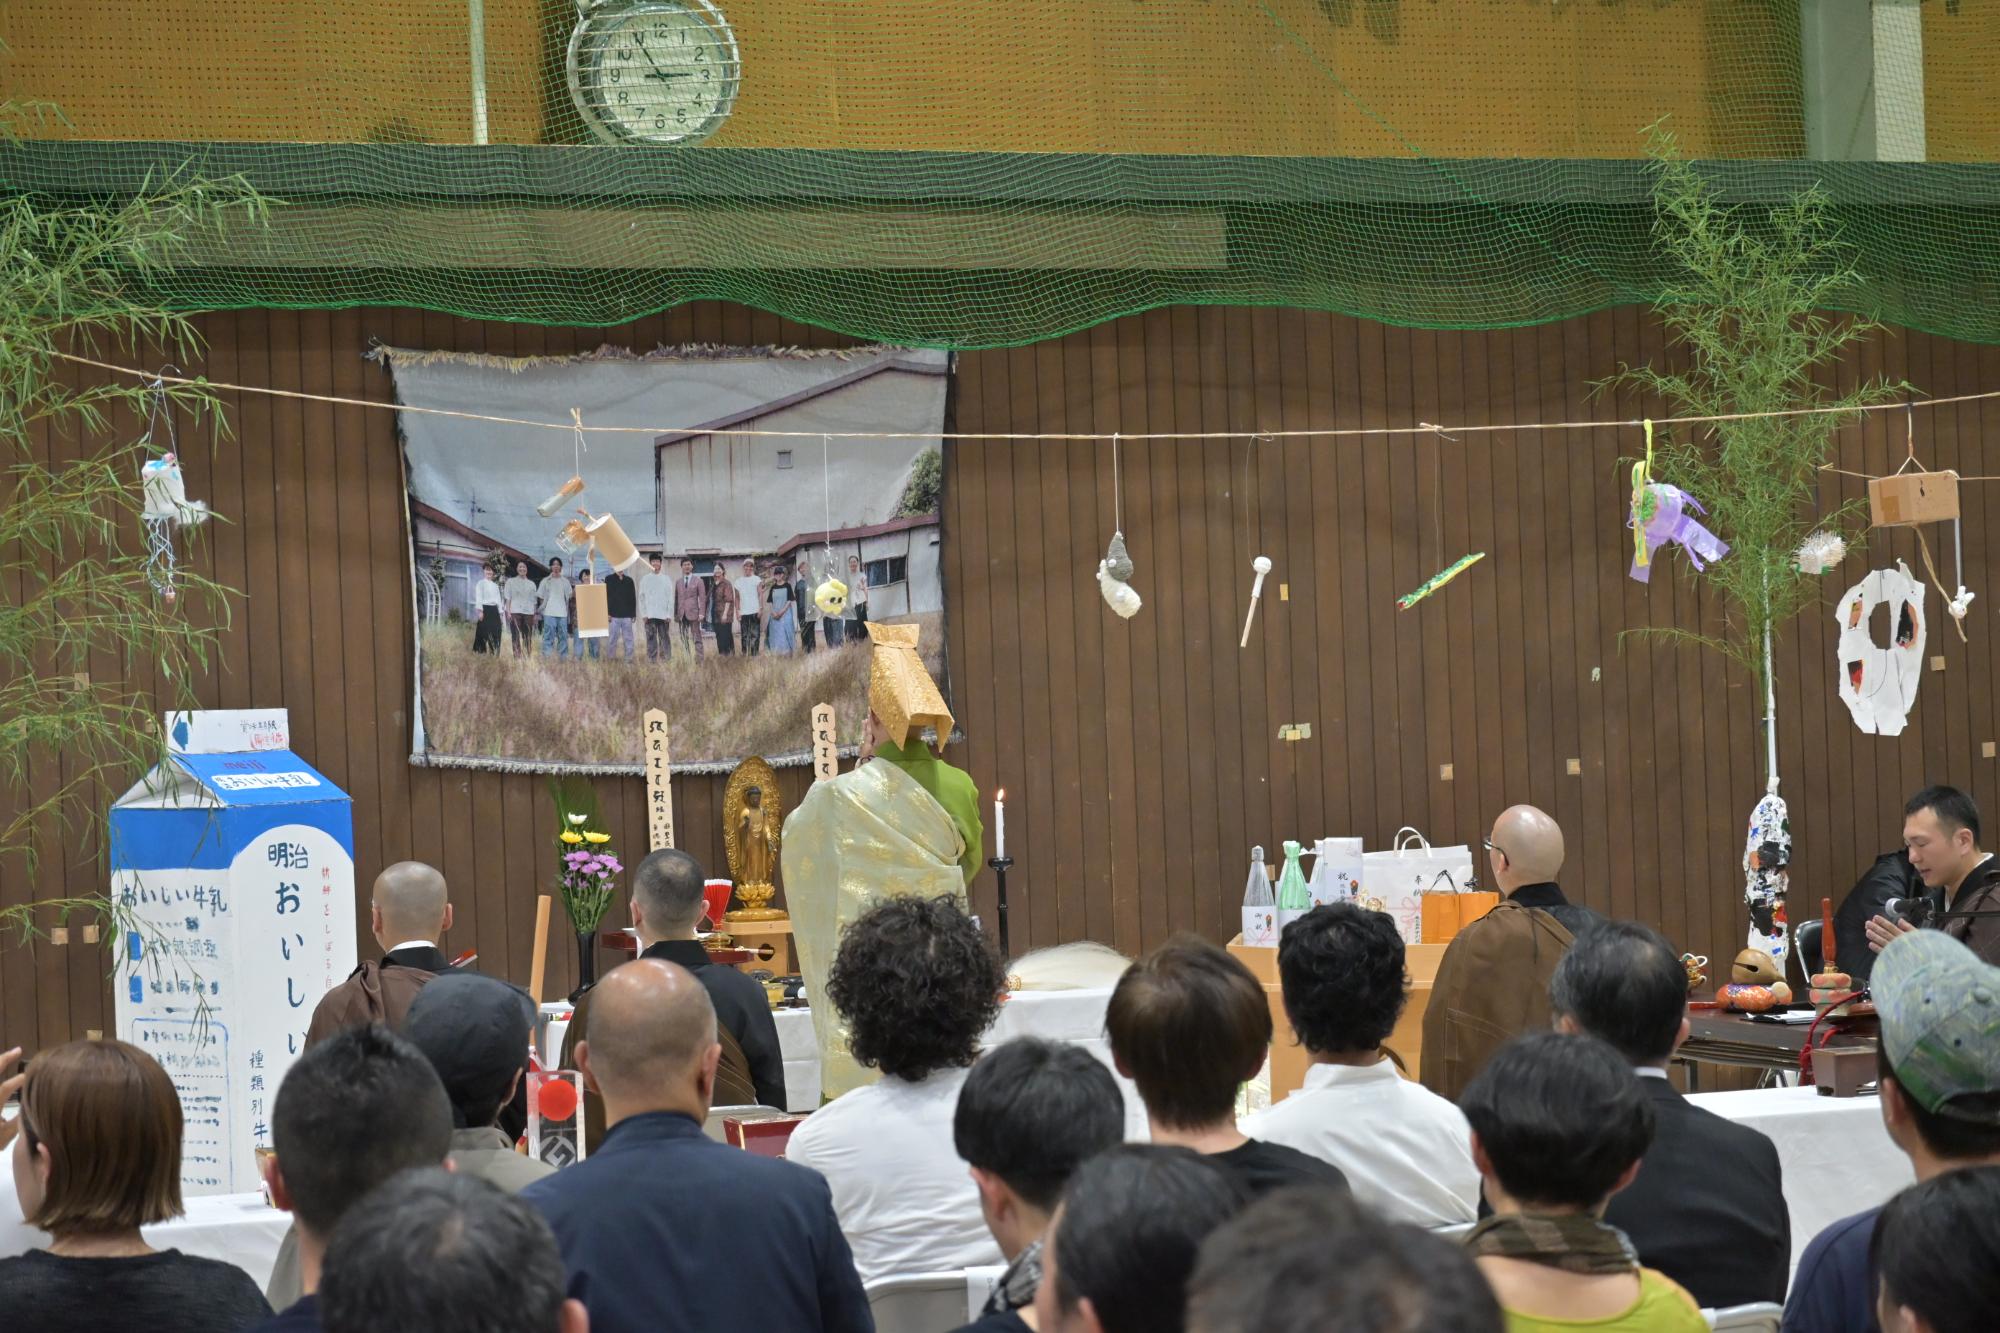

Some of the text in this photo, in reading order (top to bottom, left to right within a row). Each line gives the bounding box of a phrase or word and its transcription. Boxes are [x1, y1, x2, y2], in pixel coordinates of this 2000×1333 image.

[653, 23, 668, 38] 12
[679, 31, 685, 44] 1
[618, 49, 631, 60] 10
[694, 47, 704, 62] 2
[611, 69, 620, 82] 9
[701, 69, 711, 80] 3
[618, 91, 628, 104] 8
[693, 92, 702, 107] 4
[636, 108, 645, 119] 7
[677, 108, 686, 123] 5
[655, 114, 665, 128] 6
[268, 842, 309, 868] 明治
[121, 884, 228, 917] おいしい牛乳
